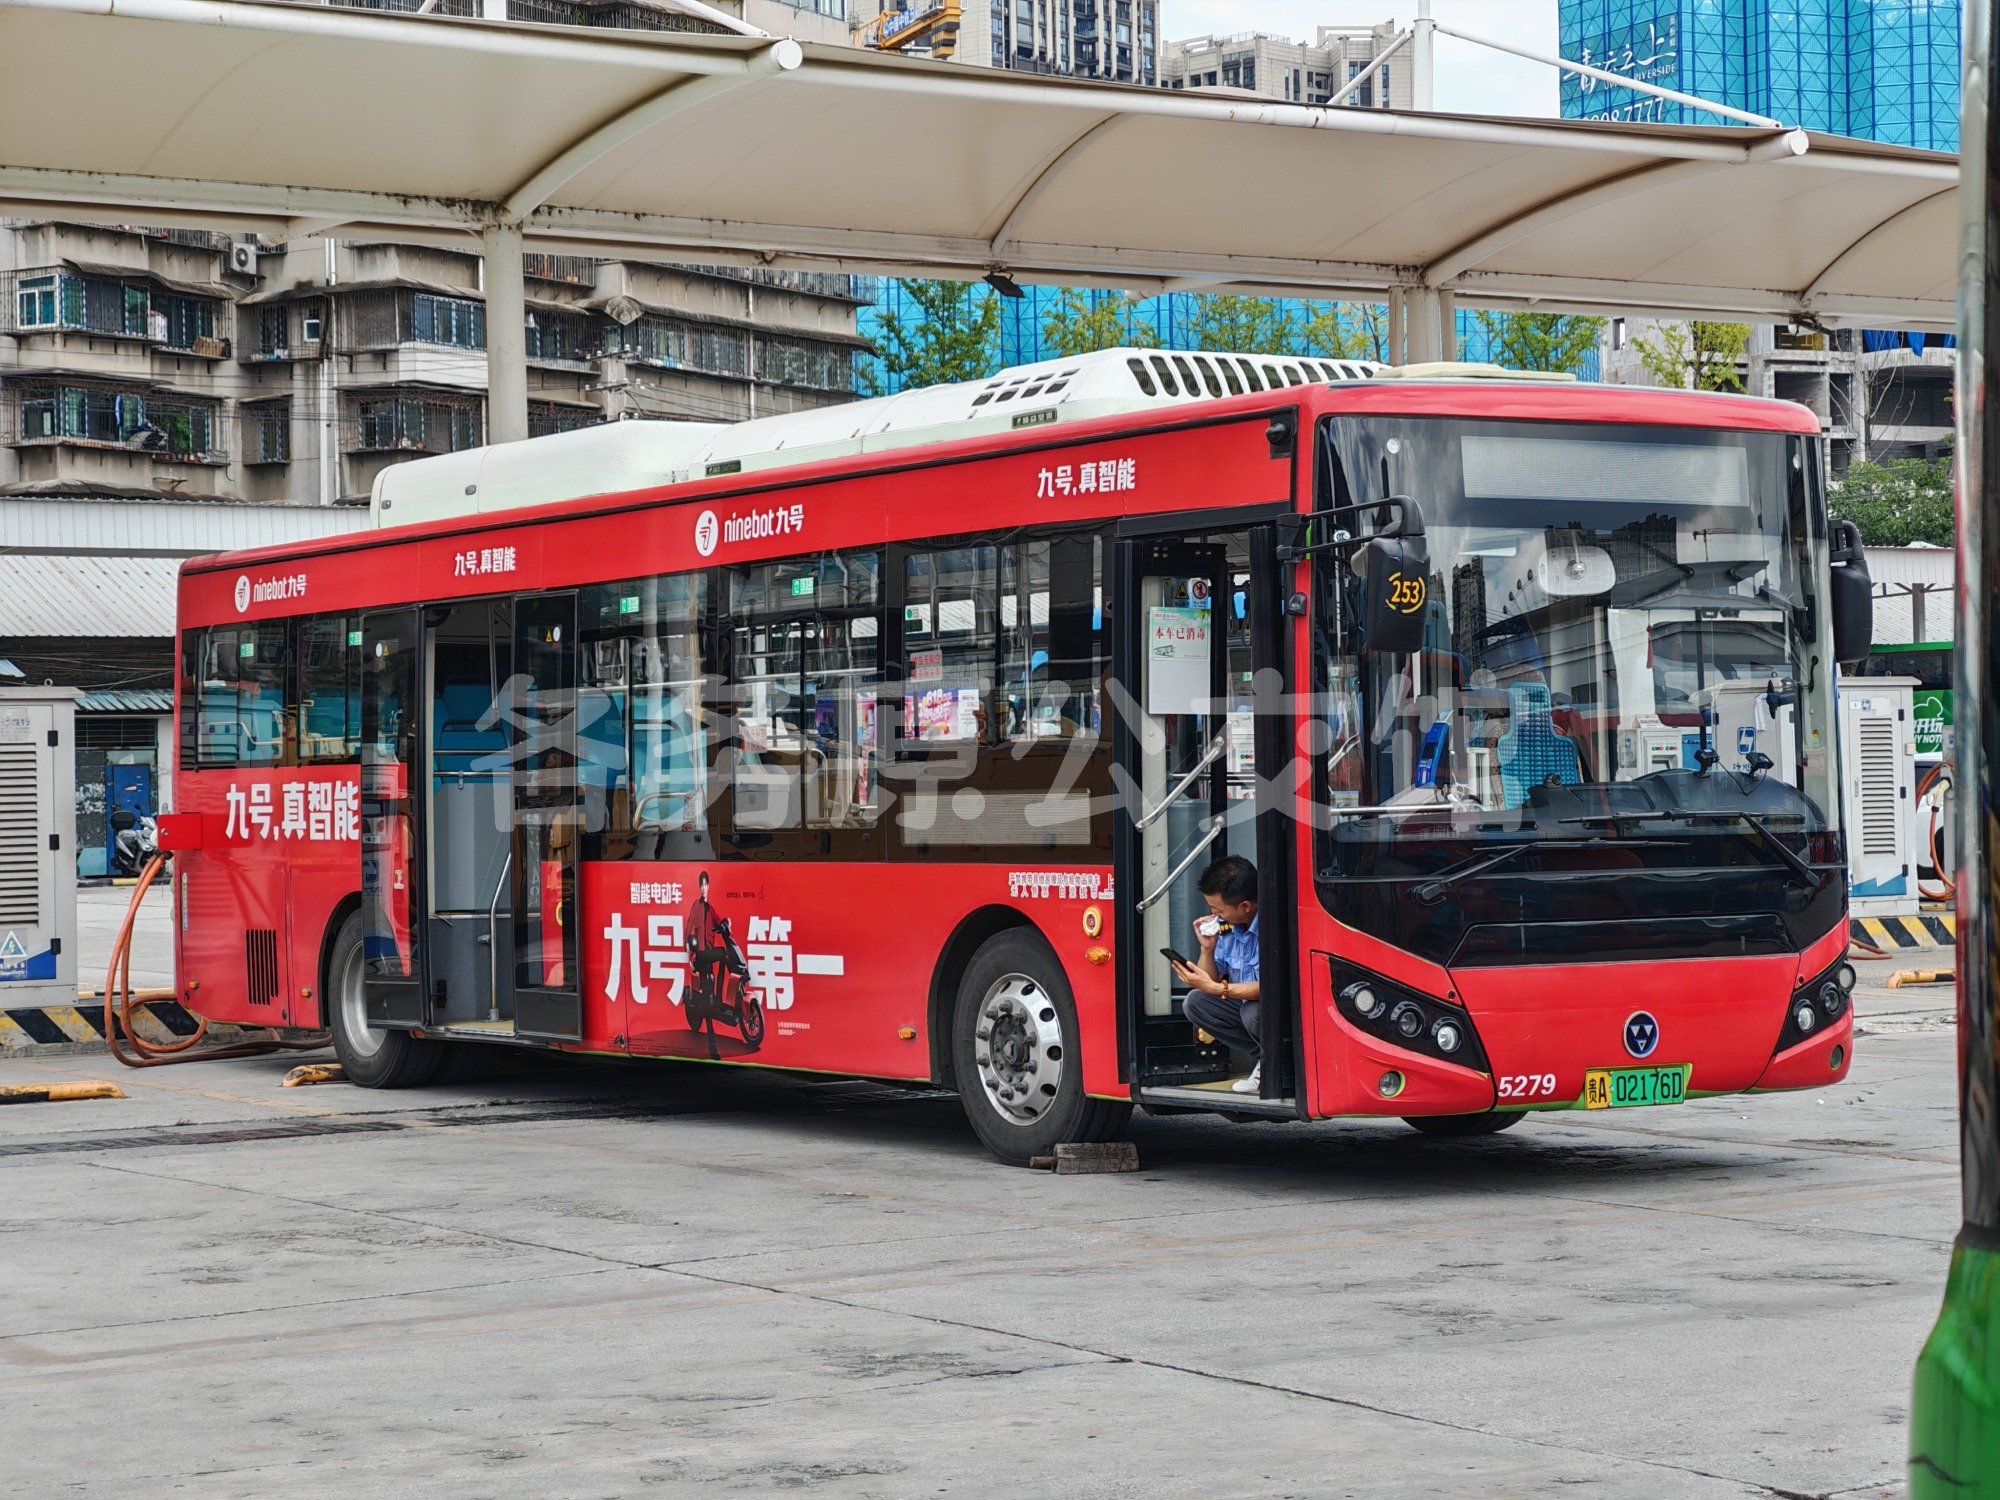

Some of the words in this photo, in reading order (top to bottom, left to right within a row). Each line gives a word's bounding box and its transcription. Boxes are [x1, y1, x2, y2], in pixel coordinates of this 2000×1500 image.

[1625, 97, 1664, 122] 7777
[1391, 580, 1420, 604] 253
[1155, 626, 1206, 641] 本车已消毒
[1914, 717, 1944, 734] 开玩
[630, 882, 682, 904] 智能电动车
[603, 912, 690, 1007] 九号
[747, 916, 844, 1011] 第一
[1498, 1073, 1556, 1098] 5279
[1589, 1076, 1608, 1104] 贵A
[1616, 1072, 1682, 1102] 02176D
